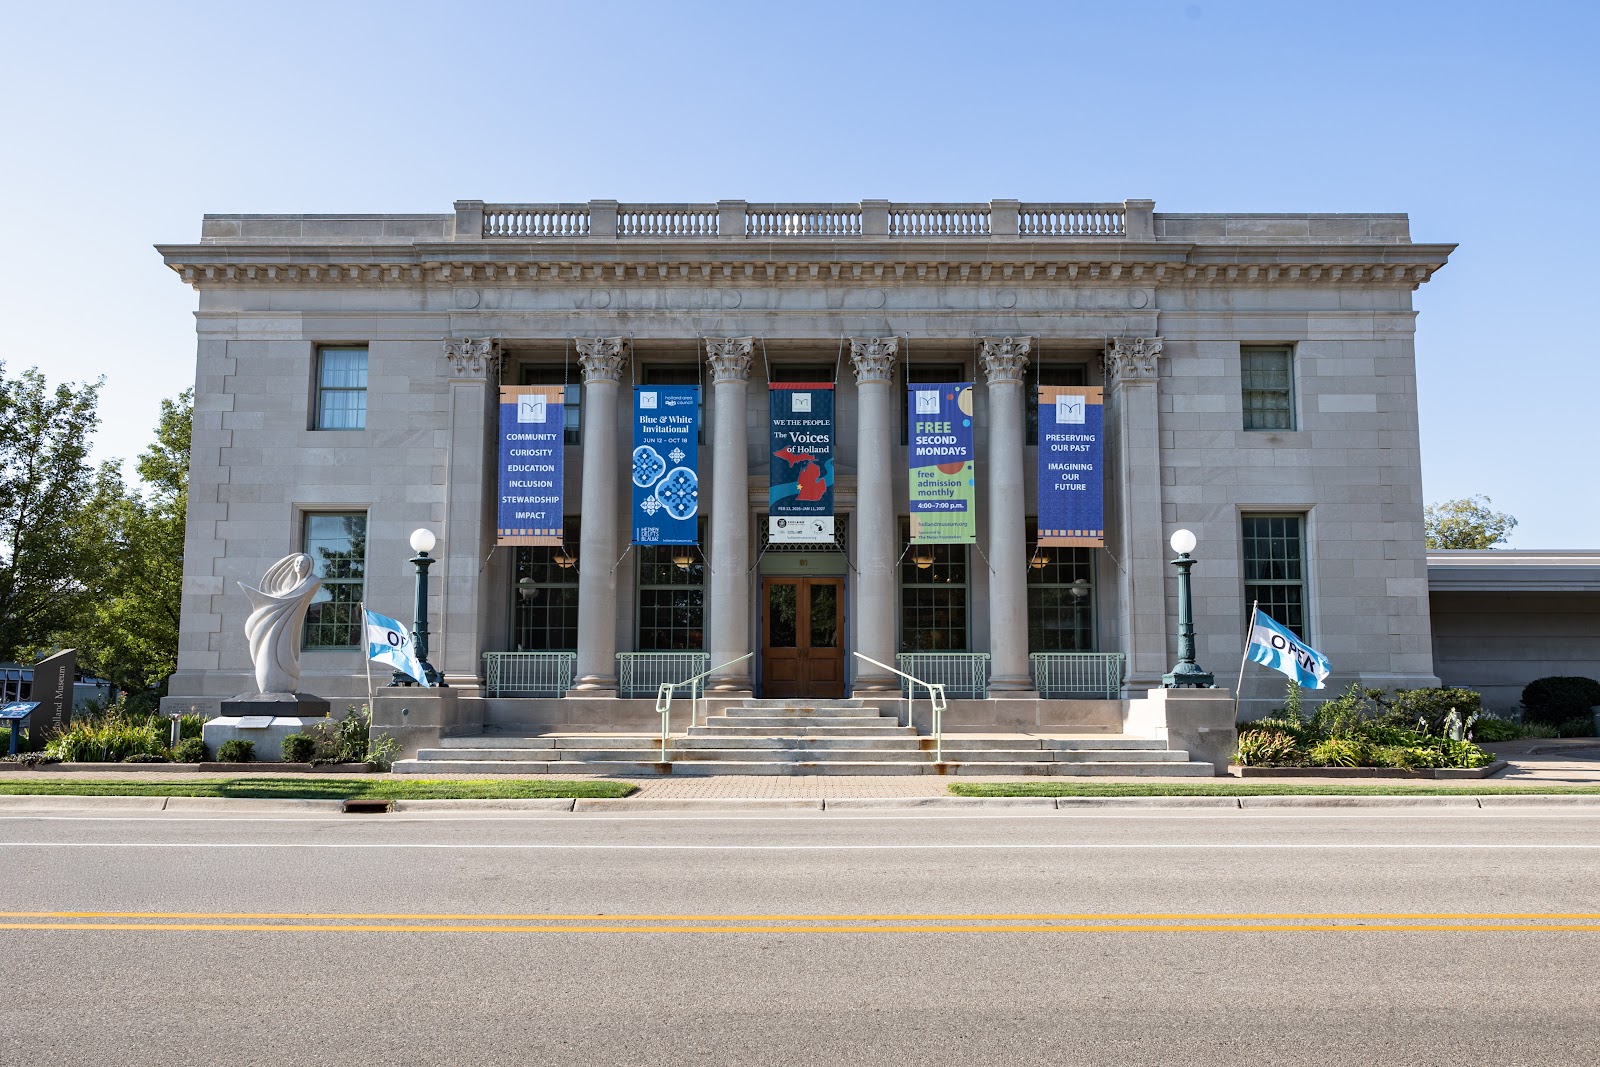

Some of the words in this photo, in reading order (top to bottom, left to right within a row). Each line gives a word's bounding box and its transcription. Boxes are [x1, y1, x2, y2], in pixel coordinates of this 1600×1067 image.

[640, 416, 658, 424] Blue
[660, 416, 668, 424] &
[668, 416, 693, 424] White
[642, 425, 689, 433] Invitational
[916, 422, 951, 434] FREE
[506, 433, 557, 441] COMMUNITY
[789, 431, 830, 443] Voices
[916, 436, 957, 445] SECOND
[916, 447, 967, 456] MONDAYS
[918, 488, 954, 497] monthly
[1271, 635, 1316, 673] OPEN
[55, 666, 65, 699] Museum
